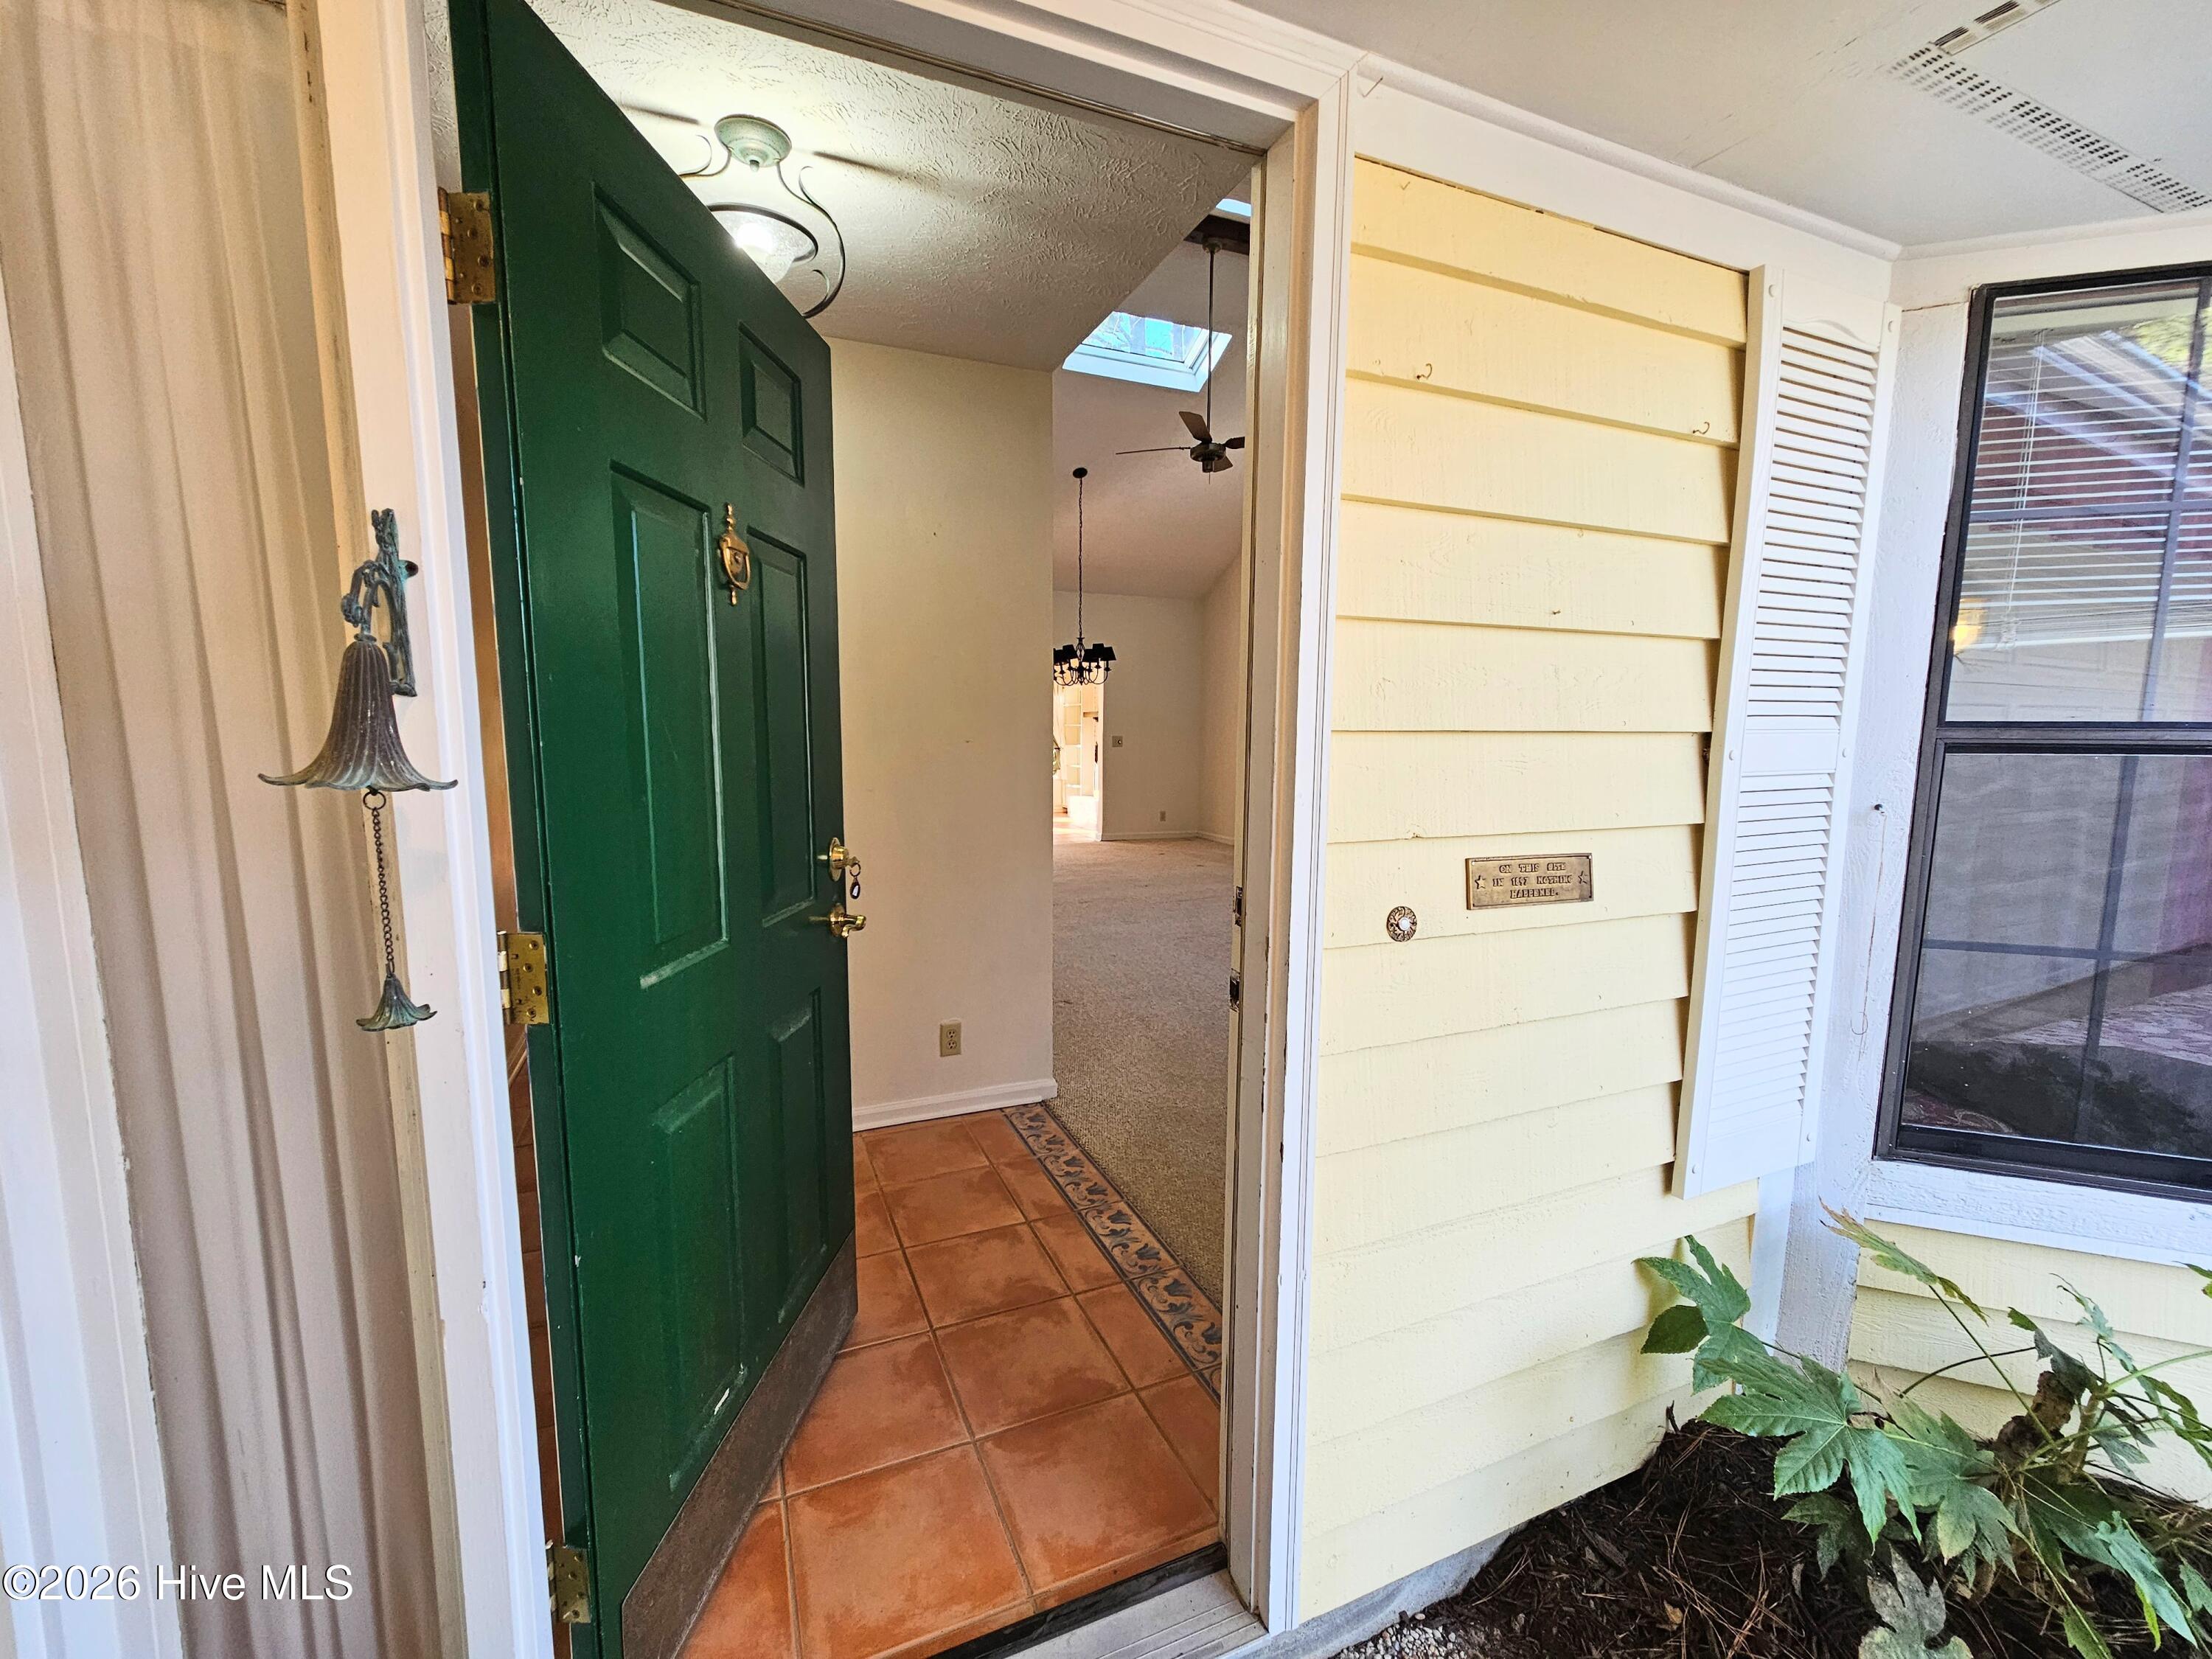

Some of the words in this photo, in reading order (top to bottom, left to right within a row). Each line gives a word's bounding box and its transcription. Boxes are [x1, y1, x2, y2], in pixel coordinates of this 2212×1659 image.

[1499, 865, 1512, 873] ON
[1519, 863, 1540, 872] THIS
[1547, 862, 1566, 871] SITE
[1492, 878, 1504, 887] IN
[1537, 874, 1572, 884] NOTHING
